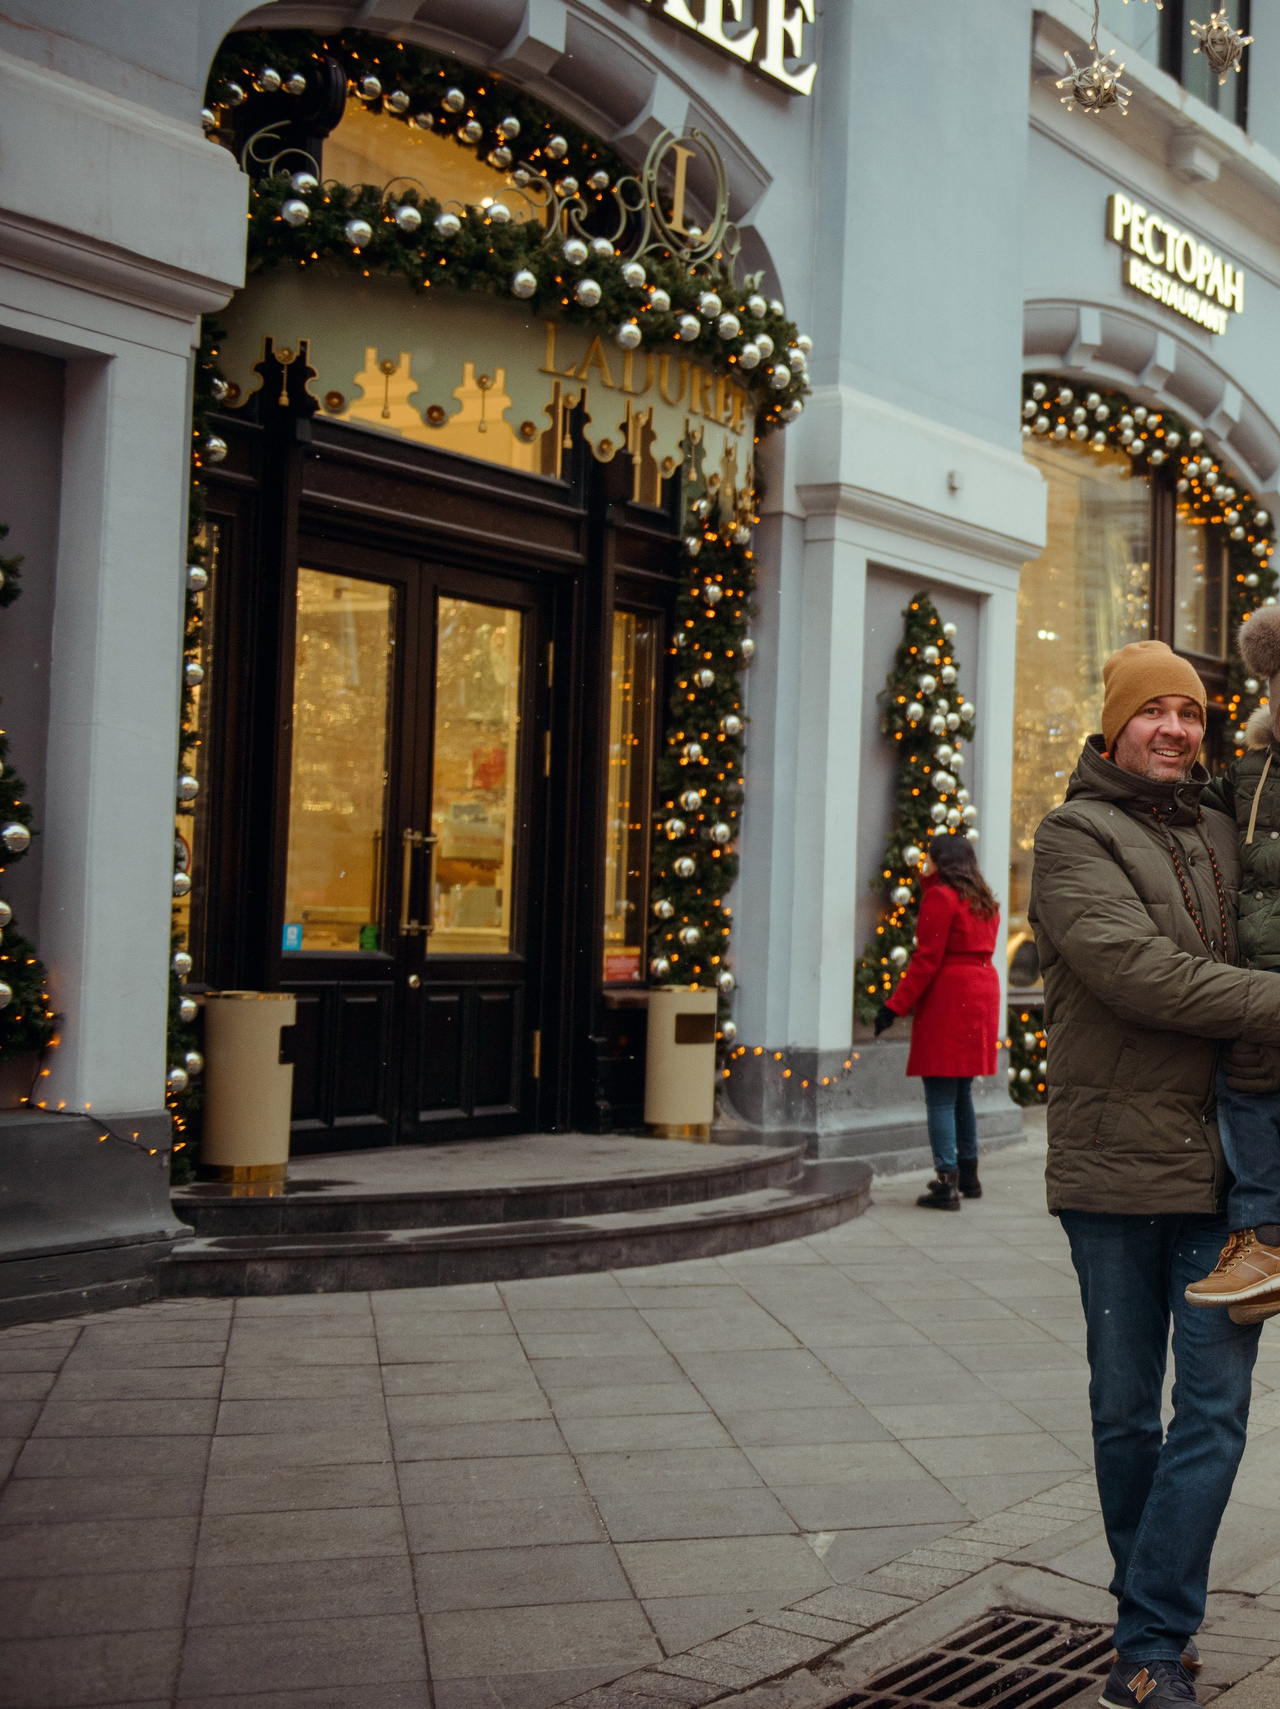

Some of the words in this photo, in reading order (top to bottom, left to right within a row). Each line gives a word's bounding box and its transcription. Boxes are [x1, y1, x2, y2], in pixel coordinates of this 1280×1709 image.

[645, 0, 817, 96] EE
[1112, 192, 1244, 314] РЕСТОРАН
[1129, 256, 1229, 336] RESTAURANT
[1127, 1667, 1157, 1704] N
